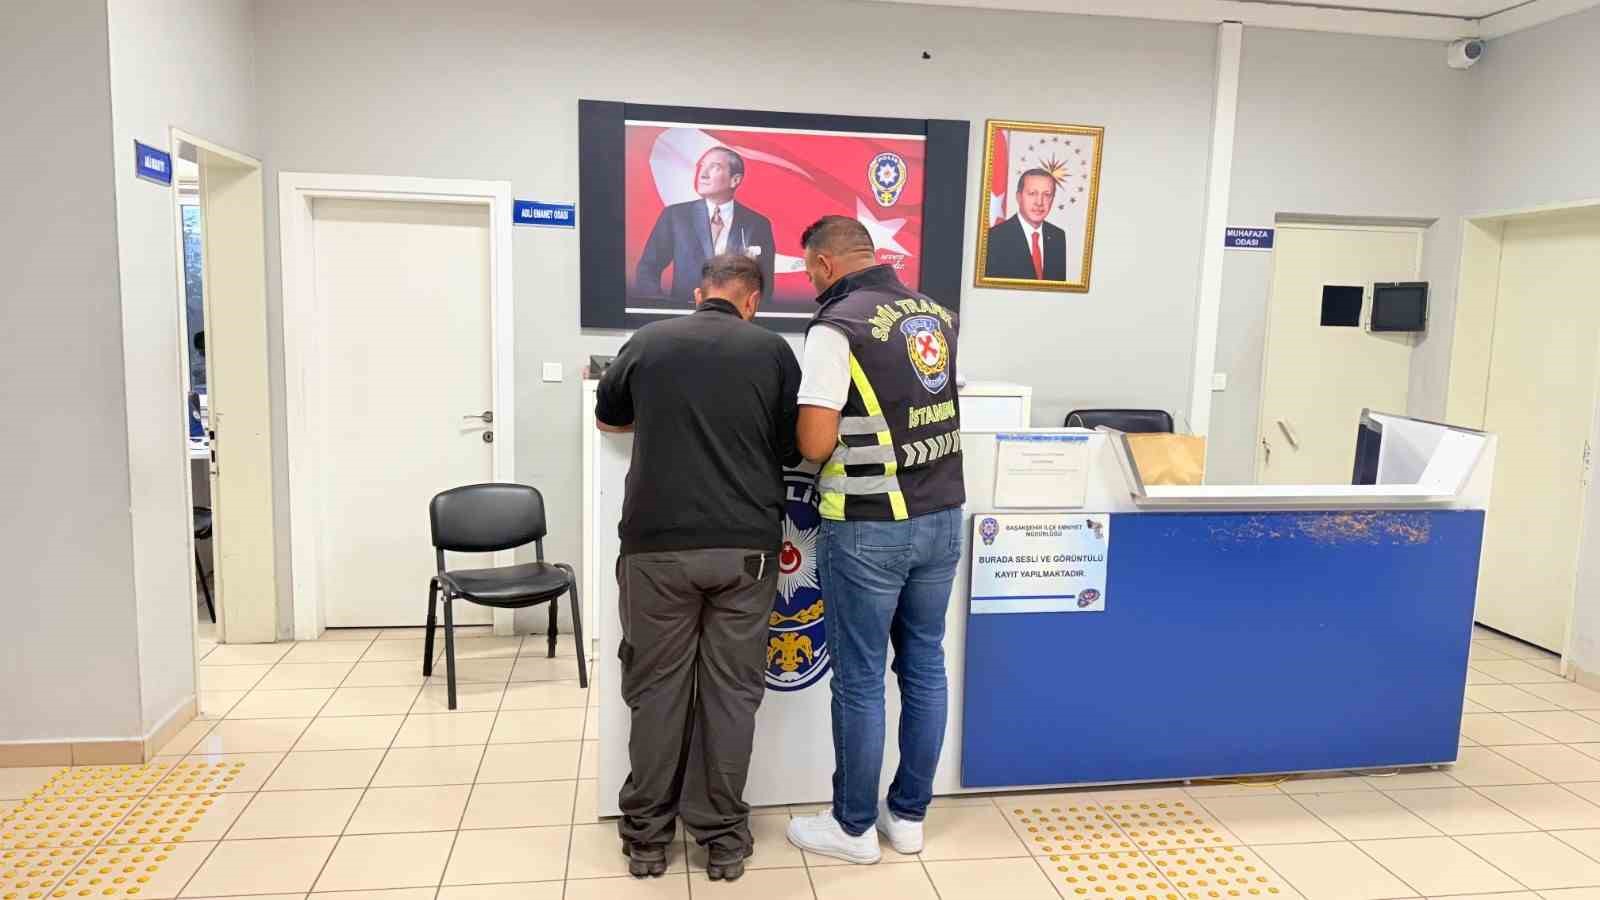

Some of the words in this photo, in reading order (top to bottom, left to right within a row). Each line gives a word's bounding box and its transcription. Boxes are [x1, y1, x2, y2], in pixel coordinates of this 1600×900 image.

[521, 207, 533, 218] ADLİ
[1227, 229, 1268, 238] MUHAFAZA
[1235, 238, 1259, 246] ODASI
[978, 555, 1014, 564] BURADA
[1015, 555, 1039, 563] SESLİ
[1053, 554, 1104, 563] GÖRÜNTÜLÜ
